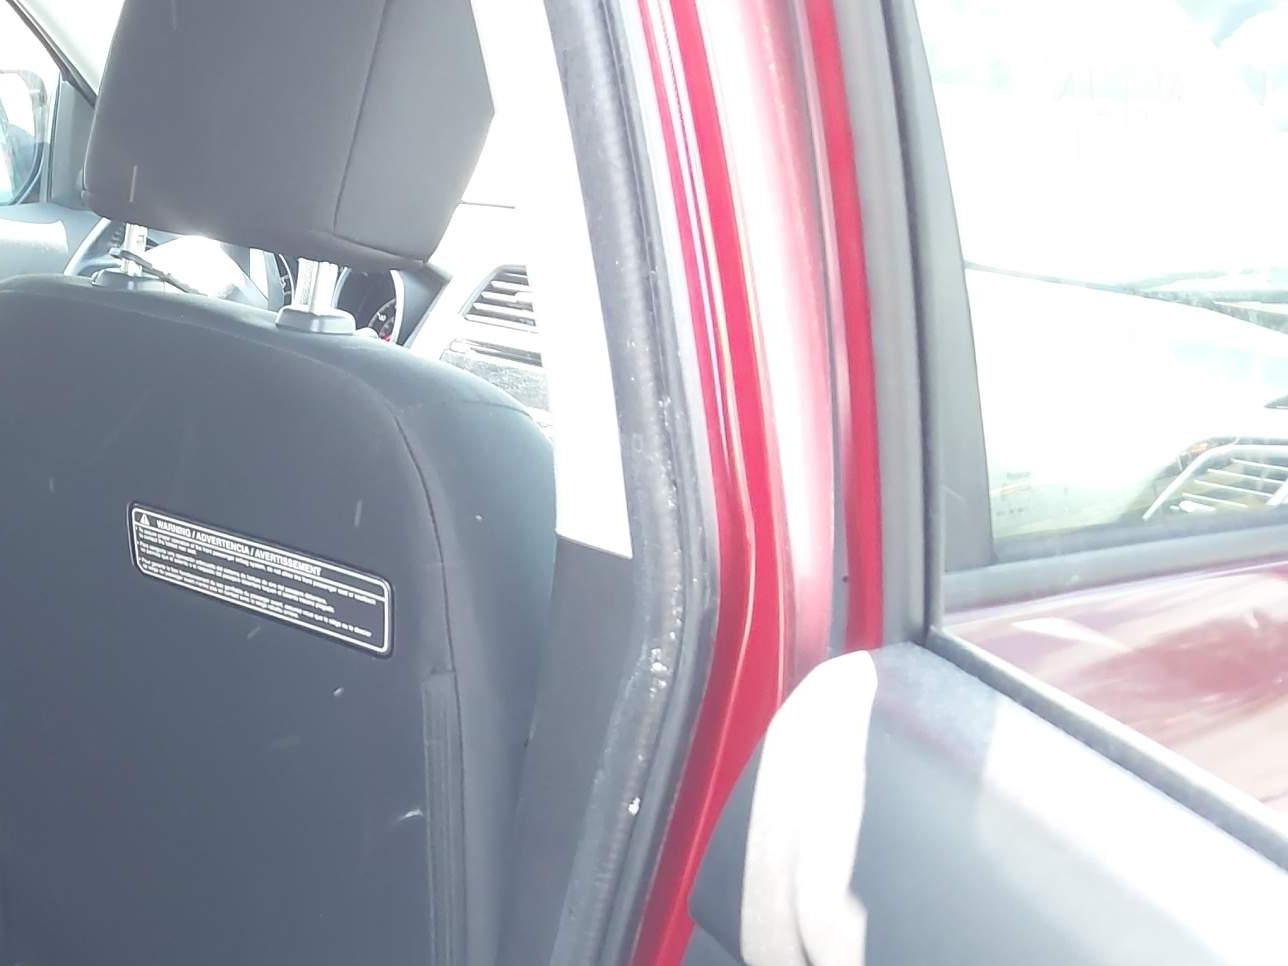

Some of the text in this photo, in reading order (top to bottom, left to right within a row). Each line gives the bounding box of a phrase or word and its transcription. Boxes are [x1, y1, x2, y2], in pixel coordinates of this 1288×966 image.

[156, 519, 191, 539] WARNING
[196, 532, 250, 554] ADVERTENCIA
[255, 548, 322, 576] AVERTISSEMENT
